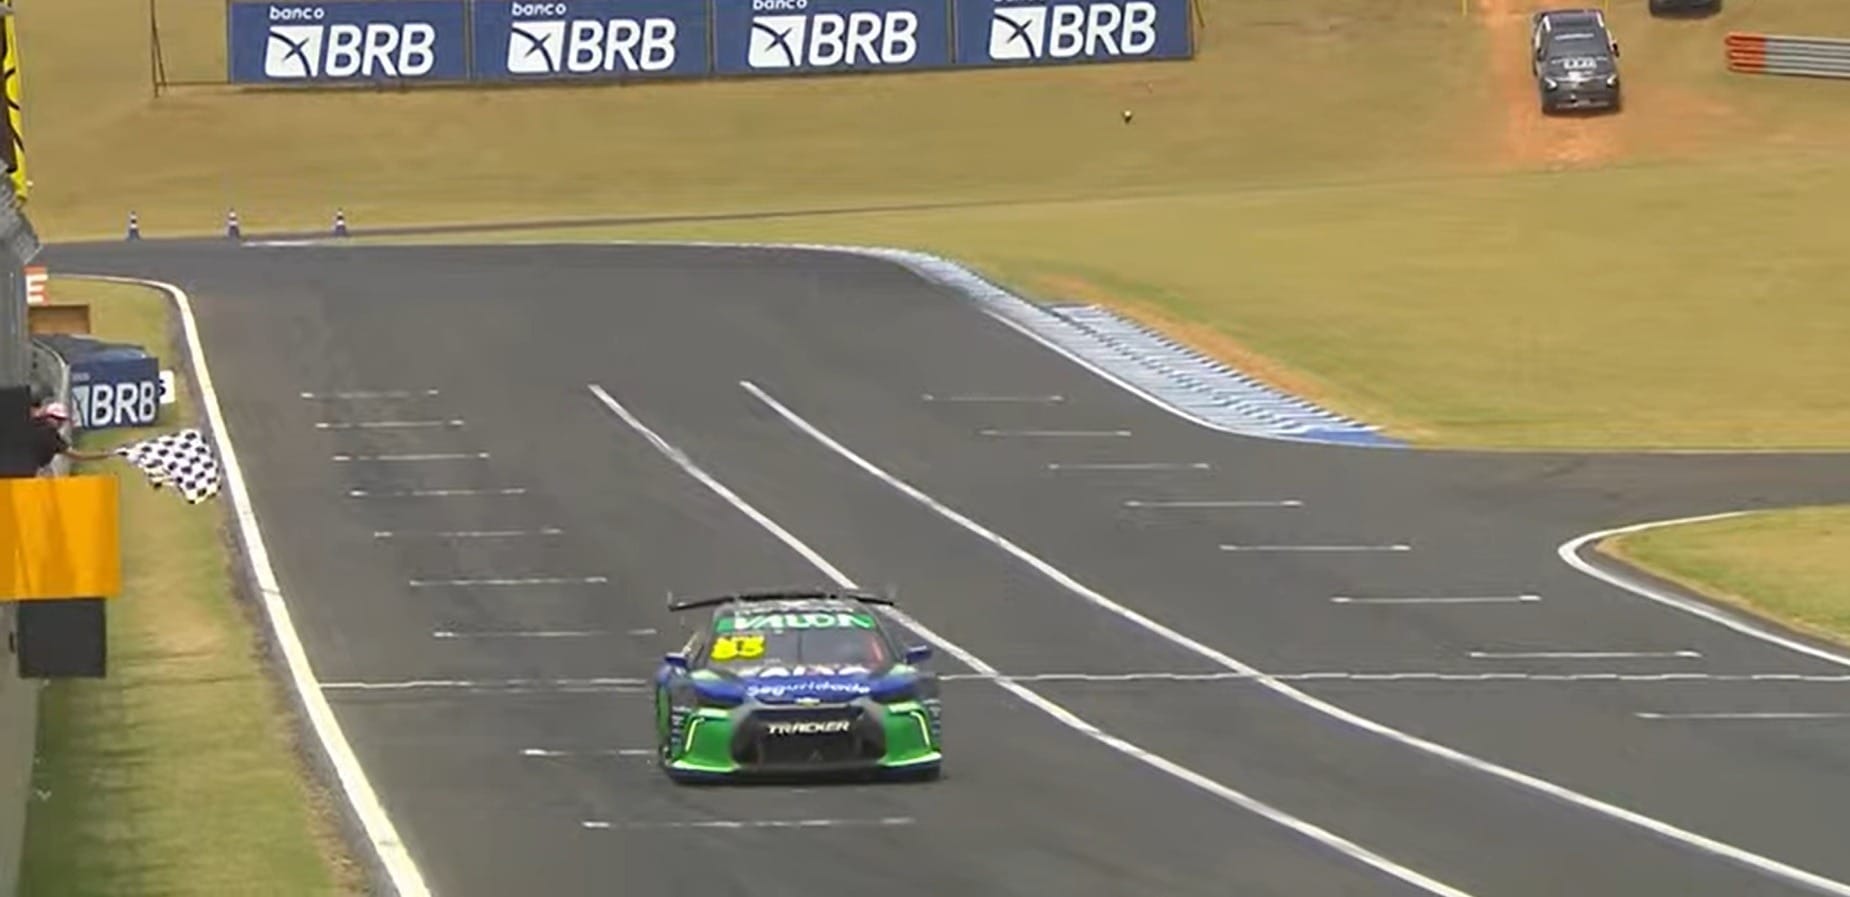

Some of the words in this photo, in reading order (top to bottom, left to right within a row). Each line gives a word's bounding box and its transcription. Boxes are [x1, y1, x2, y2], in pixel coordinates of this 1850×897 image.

[269, 6, 325, 20] banco
[512, 2, 567, 17] banco
[1049, 1, 1157, 57] BRB
[325, 23, 436, 78] BRB
[567, 18, 677, 73] BRB
[808, 11, 918, 66] BRB
[90, 381, 156, 427] BRB
[768, 720, 850, 735] TRACKER
